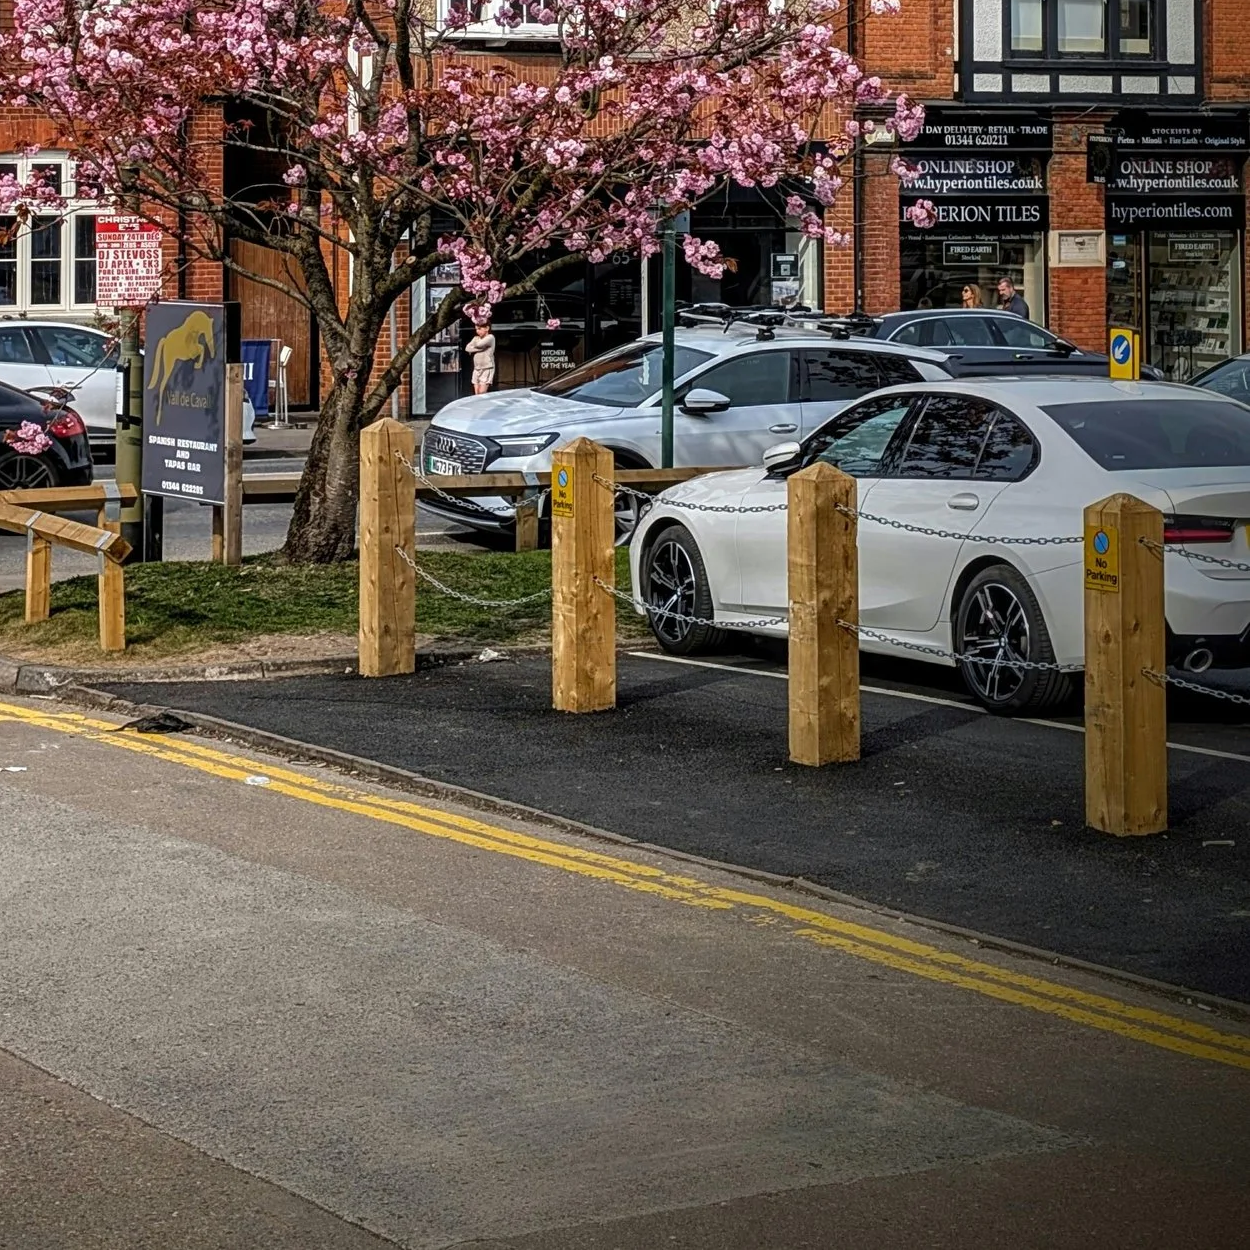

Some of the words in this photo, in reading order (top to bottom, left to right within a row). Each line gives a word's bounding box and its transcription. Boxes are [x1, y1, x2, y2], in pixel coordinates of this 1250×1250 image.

[926, 126, 943, 134] DAY
[944, 126, 983, 134] DELIVERY
[988, 126, 1016, 134] RETAIL
[1020, 126, 1048, 134] TRADE
[945, 134, 973, 145] 01344
[975, 134, 1009, 145] 620211
[1204, 136, 1229, 146] Original
[918, 160, 974, 174] ONLINE
[976, 160, 1015, 174] SHOP
[1120, 160, 1173, 174] ONLINE
[1176, 160, 1213, 174] SHOP
[995, 205, 1040, 222] TILES
[1111, 202, 1233, 223] hyperiontiles.com
[97, 233, 126, 241] SUNDAY
[127, 233, 145, 241] 24TH
[146, 233, 160, 241] DEC
[98, 250, 110, 260] DJ
[113, 250, 159, 260] STEVOSS
[950, 246, 970, 254] FIRED
[970, 246, 992, 254] EARTH
[612, 251, 630, 264] 65
[98, 260, 108, 269] DJ
[111, 260, 133, 269] APEX
[143, 260, 159, 269] EK3
[180, 391, 190, 407] de
[148, 435, 176, 447] SPANISH
[177, 438, 218, 452] RESTAURANT
[176, 450, 190, 459] AND
[164, 459, 186, 470] TAPAS
[187, 462, 201, 472] BAR
[161, 480, 180, 491] 01344
[558, 489, 567, 499] No
[553, 499, 573, 512] Parking
[1095, 558, 1108, 569] No
[1086, 569, 1118, 585] Parking
